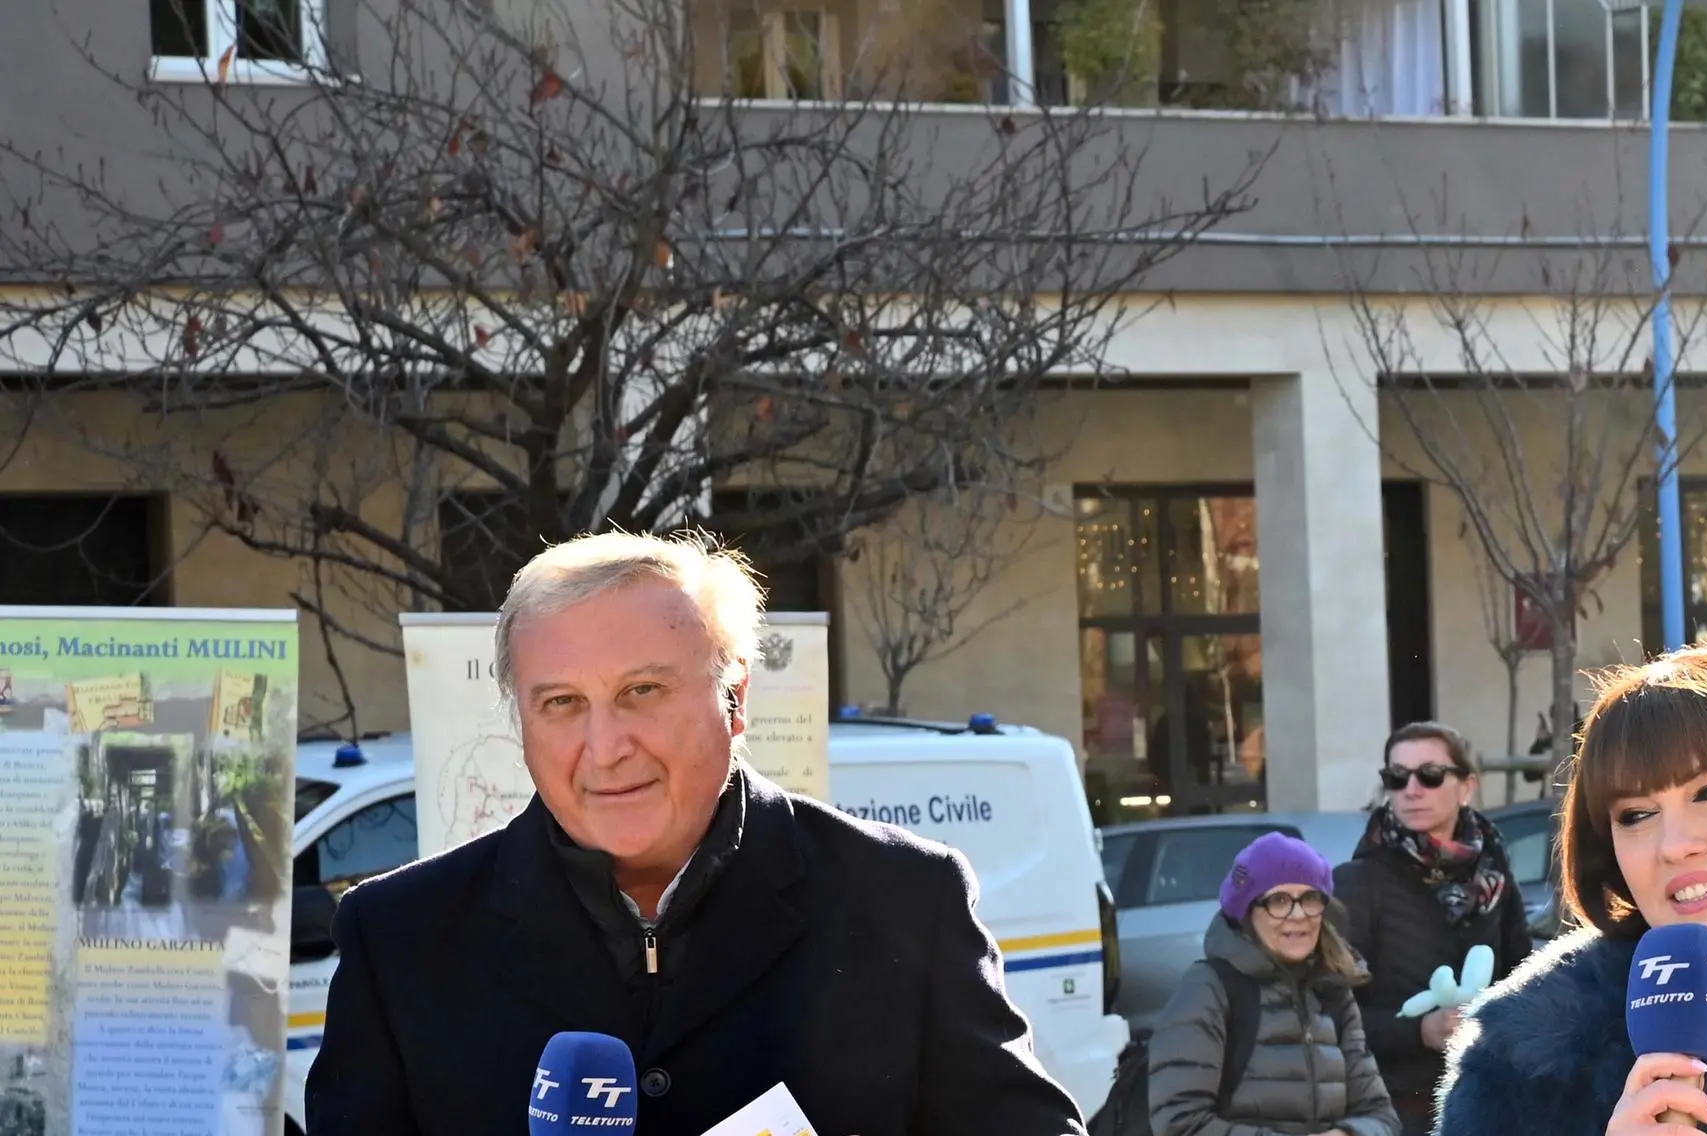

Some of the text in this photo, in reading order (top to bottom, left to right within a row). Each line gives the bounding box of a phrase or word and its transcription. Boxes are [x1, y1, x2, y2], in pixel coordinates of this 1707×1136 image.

[56, 636, 179, 658] Macinanti
[186, 639, 287, 660] MULINI
[928, 794, 993, 824] Civile
[79, 936, 226, 952] MULINO GARZETTA
[1630, 992, 1694, 1010] TELETUTTO
[570, 1116, 634, 1127] TELETUTTO
